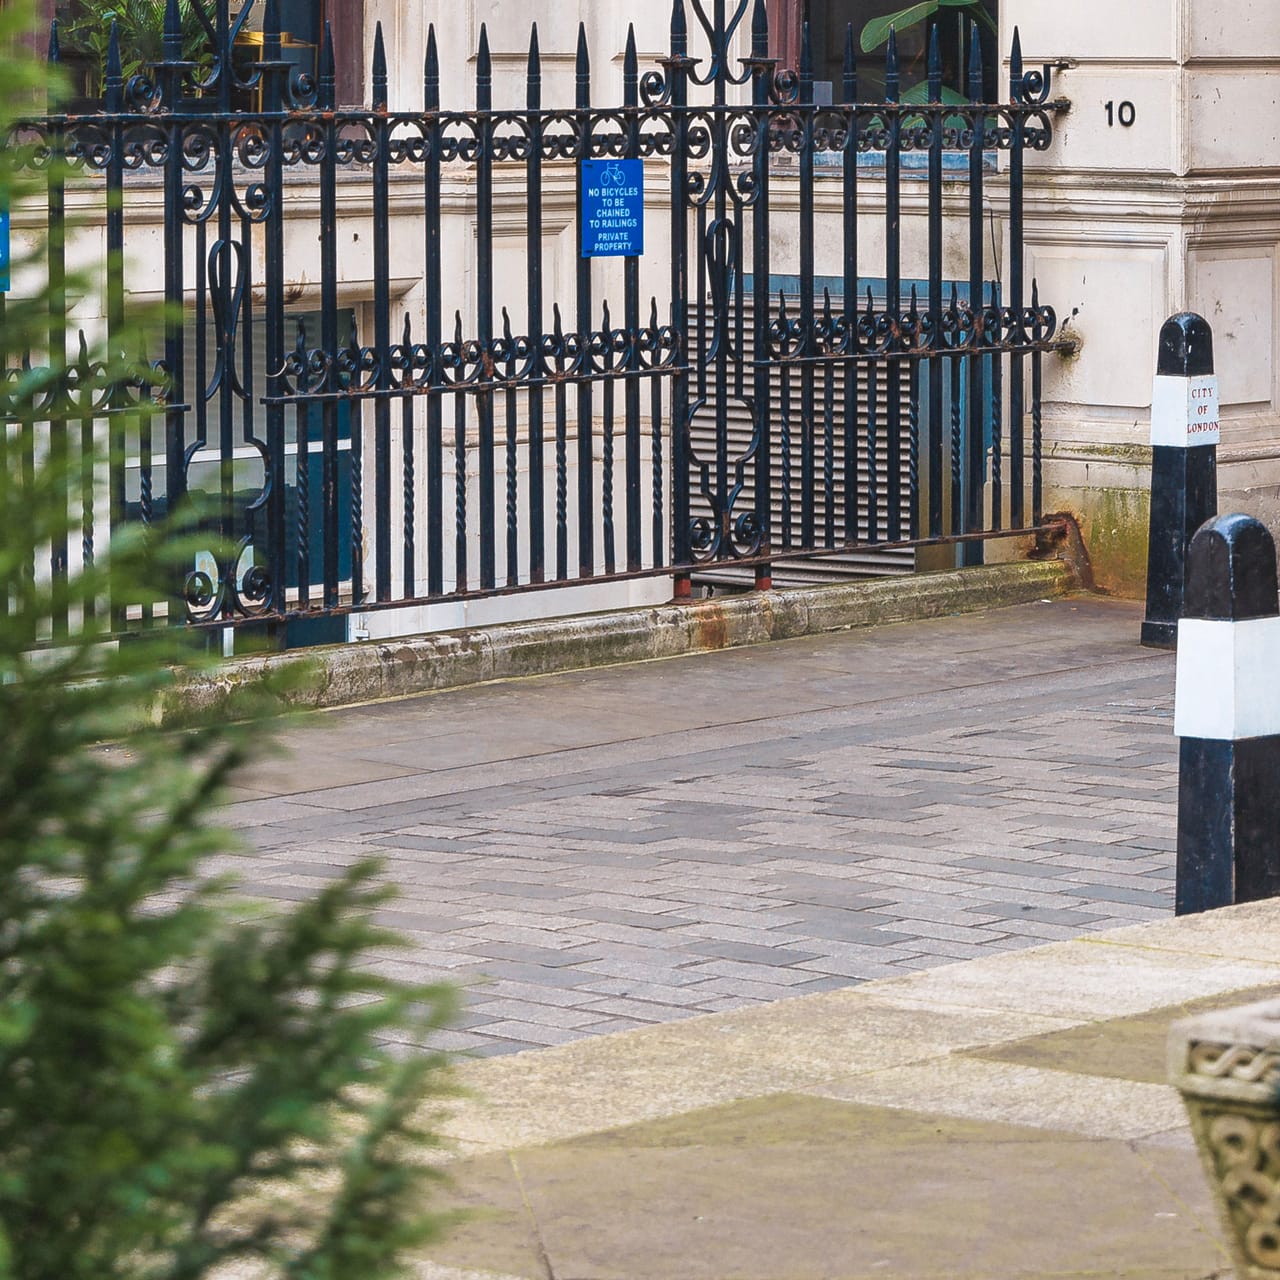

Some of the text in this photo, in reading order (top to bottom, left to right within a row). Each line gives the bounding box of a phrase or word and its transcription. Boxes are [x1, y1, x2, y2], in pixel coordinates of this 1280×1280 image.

[1105, 101, 1135, 127] 10
[589, 187, 638, 197] NO BICYCLES
[597, 209, 630, 217] CHAINED
[589, 219, 637, 228] TO RAILINGS
[598, 232, 628, 241] PRIVATE
[594, 242, 632, 251] PROPERTY
[1192, 387, 1213, 399] CITY
[1197, 405, 1208, 415] OF
[1187, 422, 1219, 433] LONDON
